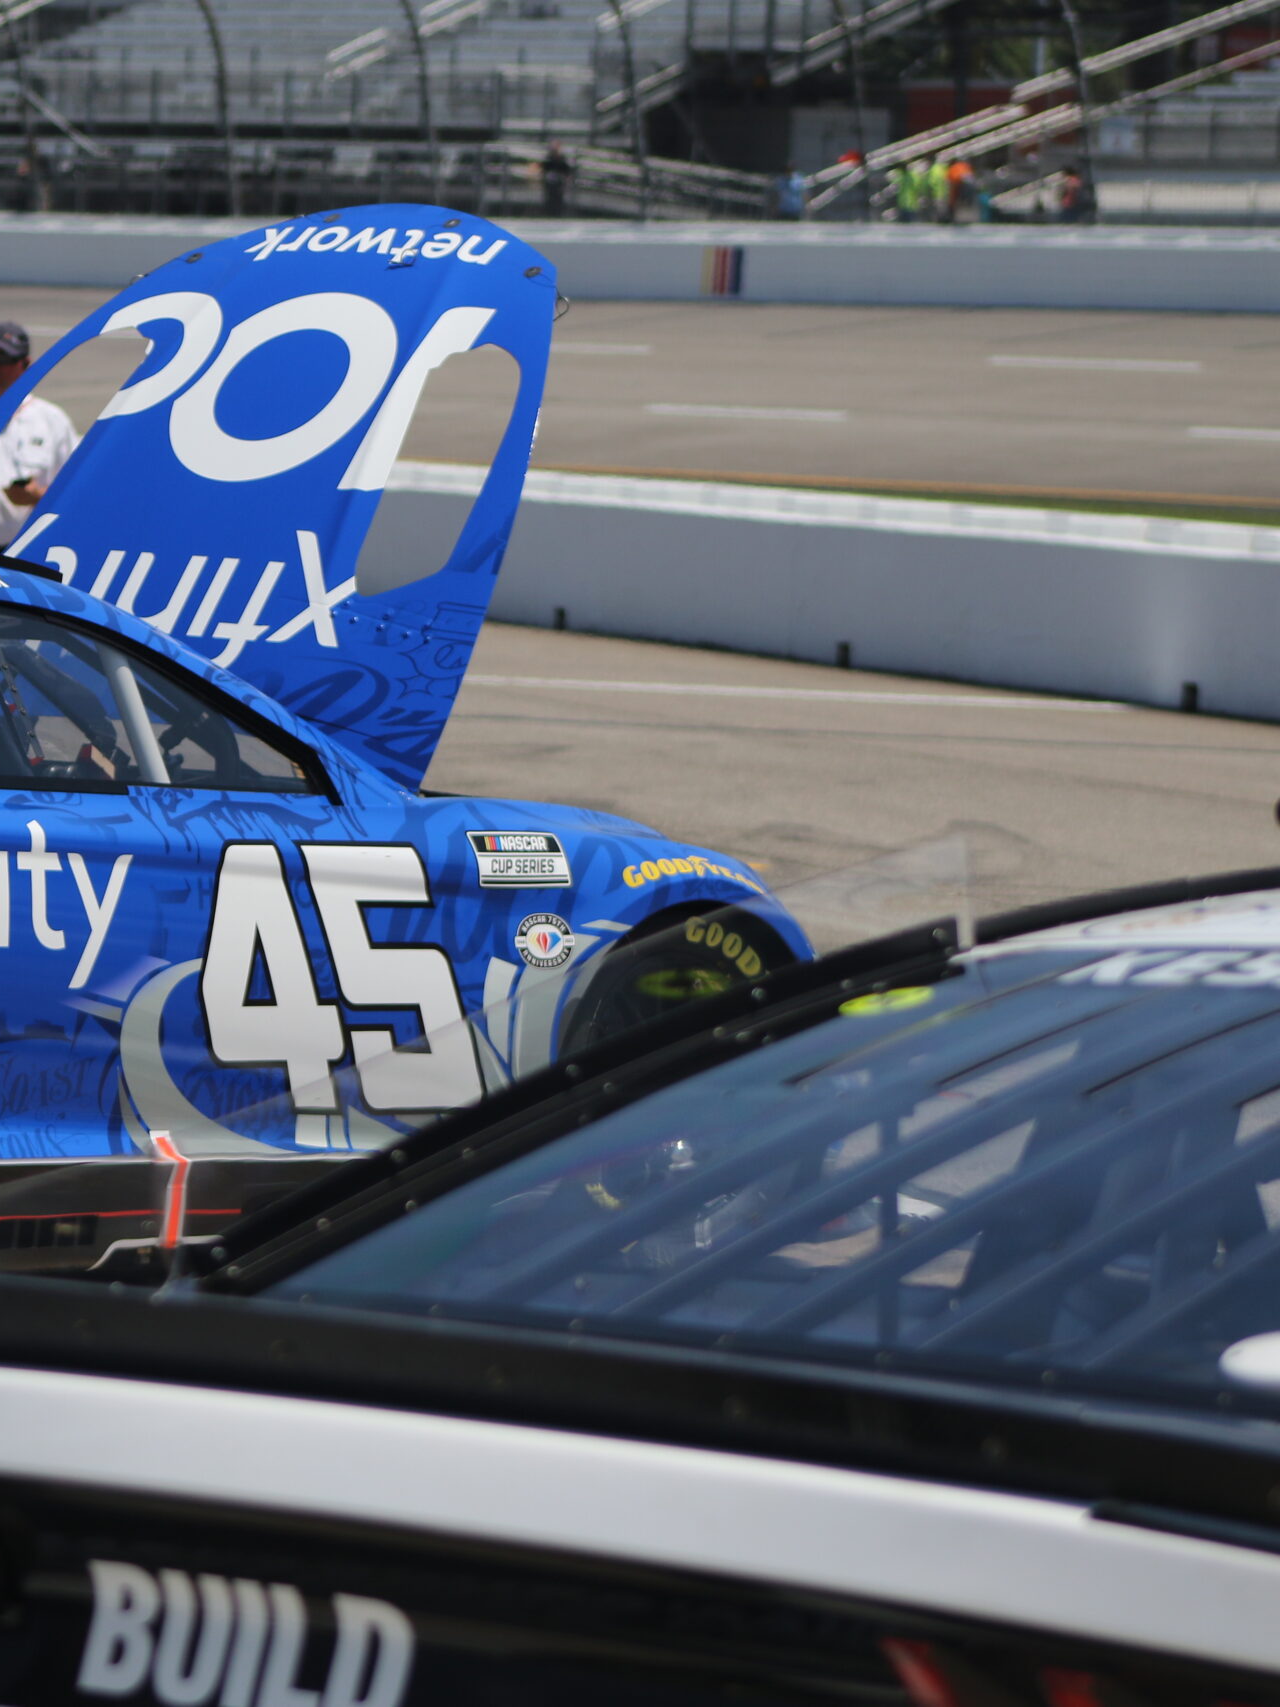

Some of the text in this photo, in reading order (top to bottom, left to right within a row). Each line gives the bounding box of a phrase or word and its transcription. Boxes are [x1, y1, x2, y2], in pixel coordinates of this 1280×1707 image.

[244, 226, 508, 265] network
[490, 858, 555, 874] CUP SERIES
[500, 835, 548, 852] NASCAR
[684, 916, 761, 978] GOOD
[201, 839, 485, 1115] 45
[76, 1558, 414, 1707] BUILD
